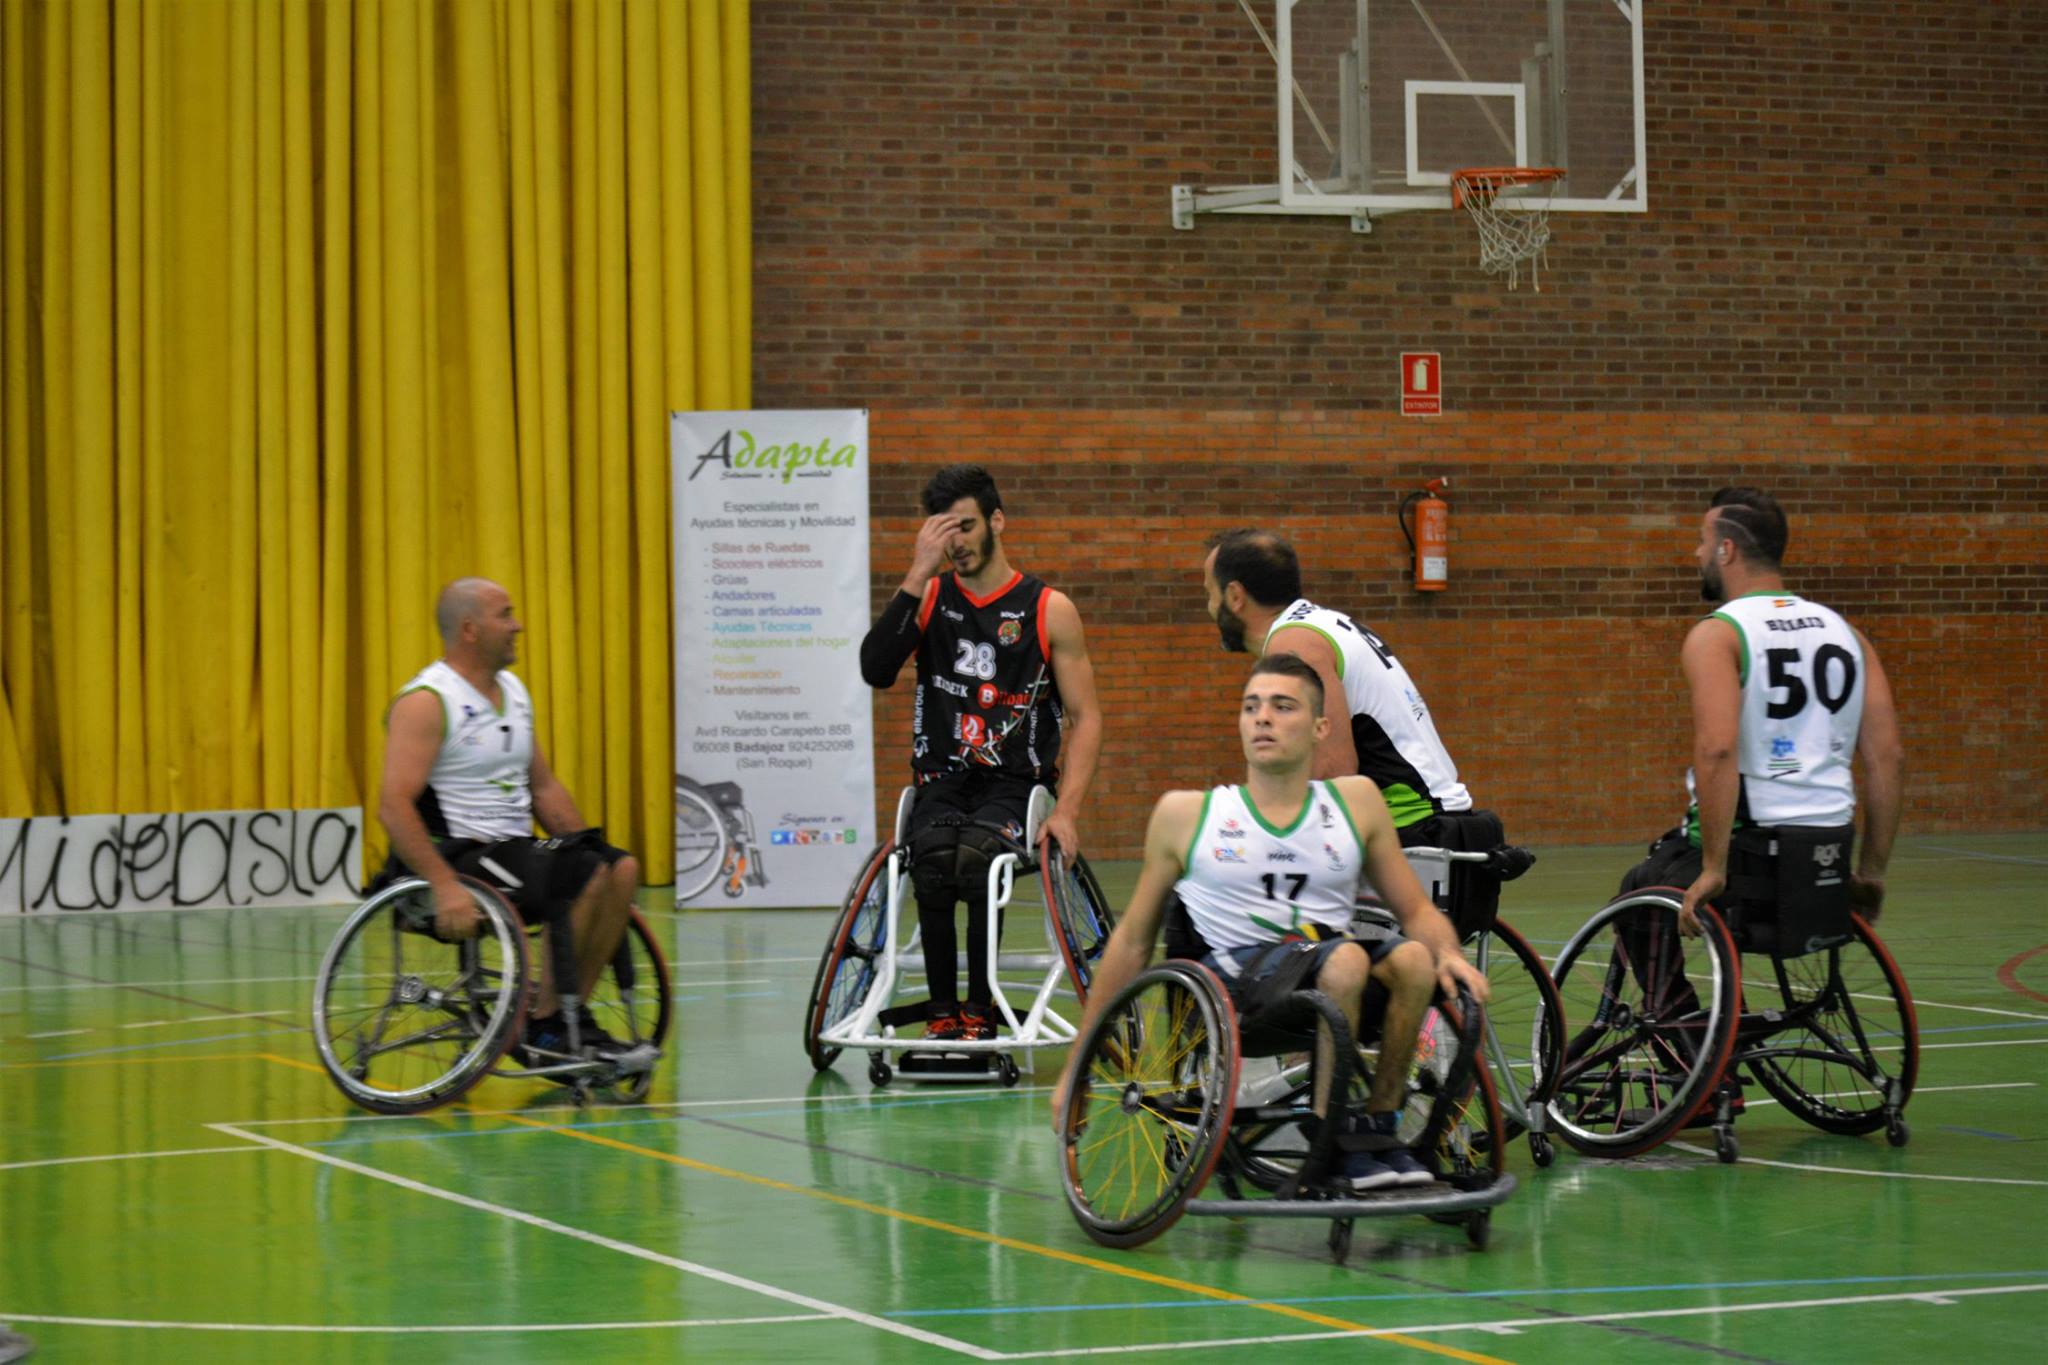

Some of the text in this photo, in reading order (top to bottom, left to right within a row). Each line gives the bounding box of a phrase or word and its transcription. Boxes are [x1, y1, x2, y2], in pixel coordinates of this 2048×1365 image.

[689, 430, 857, 484] Adapta
[724, 501, 820, 514] Especialistas en
[690, 516, 855, 530] Ayudas técnicas y Movilidad
[712, 542, 810, 554] Sillas de Ruedas
[712, 558, 824, 569] Scooters eléctricos
[712, 590, 775, 600] Andadores
[713, 605, 822, 617] Camas articuladas
[712, 622, 756, 633] Ayudas
[954, 638, 997, 681] 28
[1765, 643, 1857, 720] 50
[713, 685, 801, 696] Mantenimiento
[721, 726, 767, 736] Ricardo
[771, 725, 826, 738] Carapeto
[733, 741, 785, 754] Badajoz
[736, 757, 812, 770] (San Roque)
[1261, 872, 1308, 900] 17
